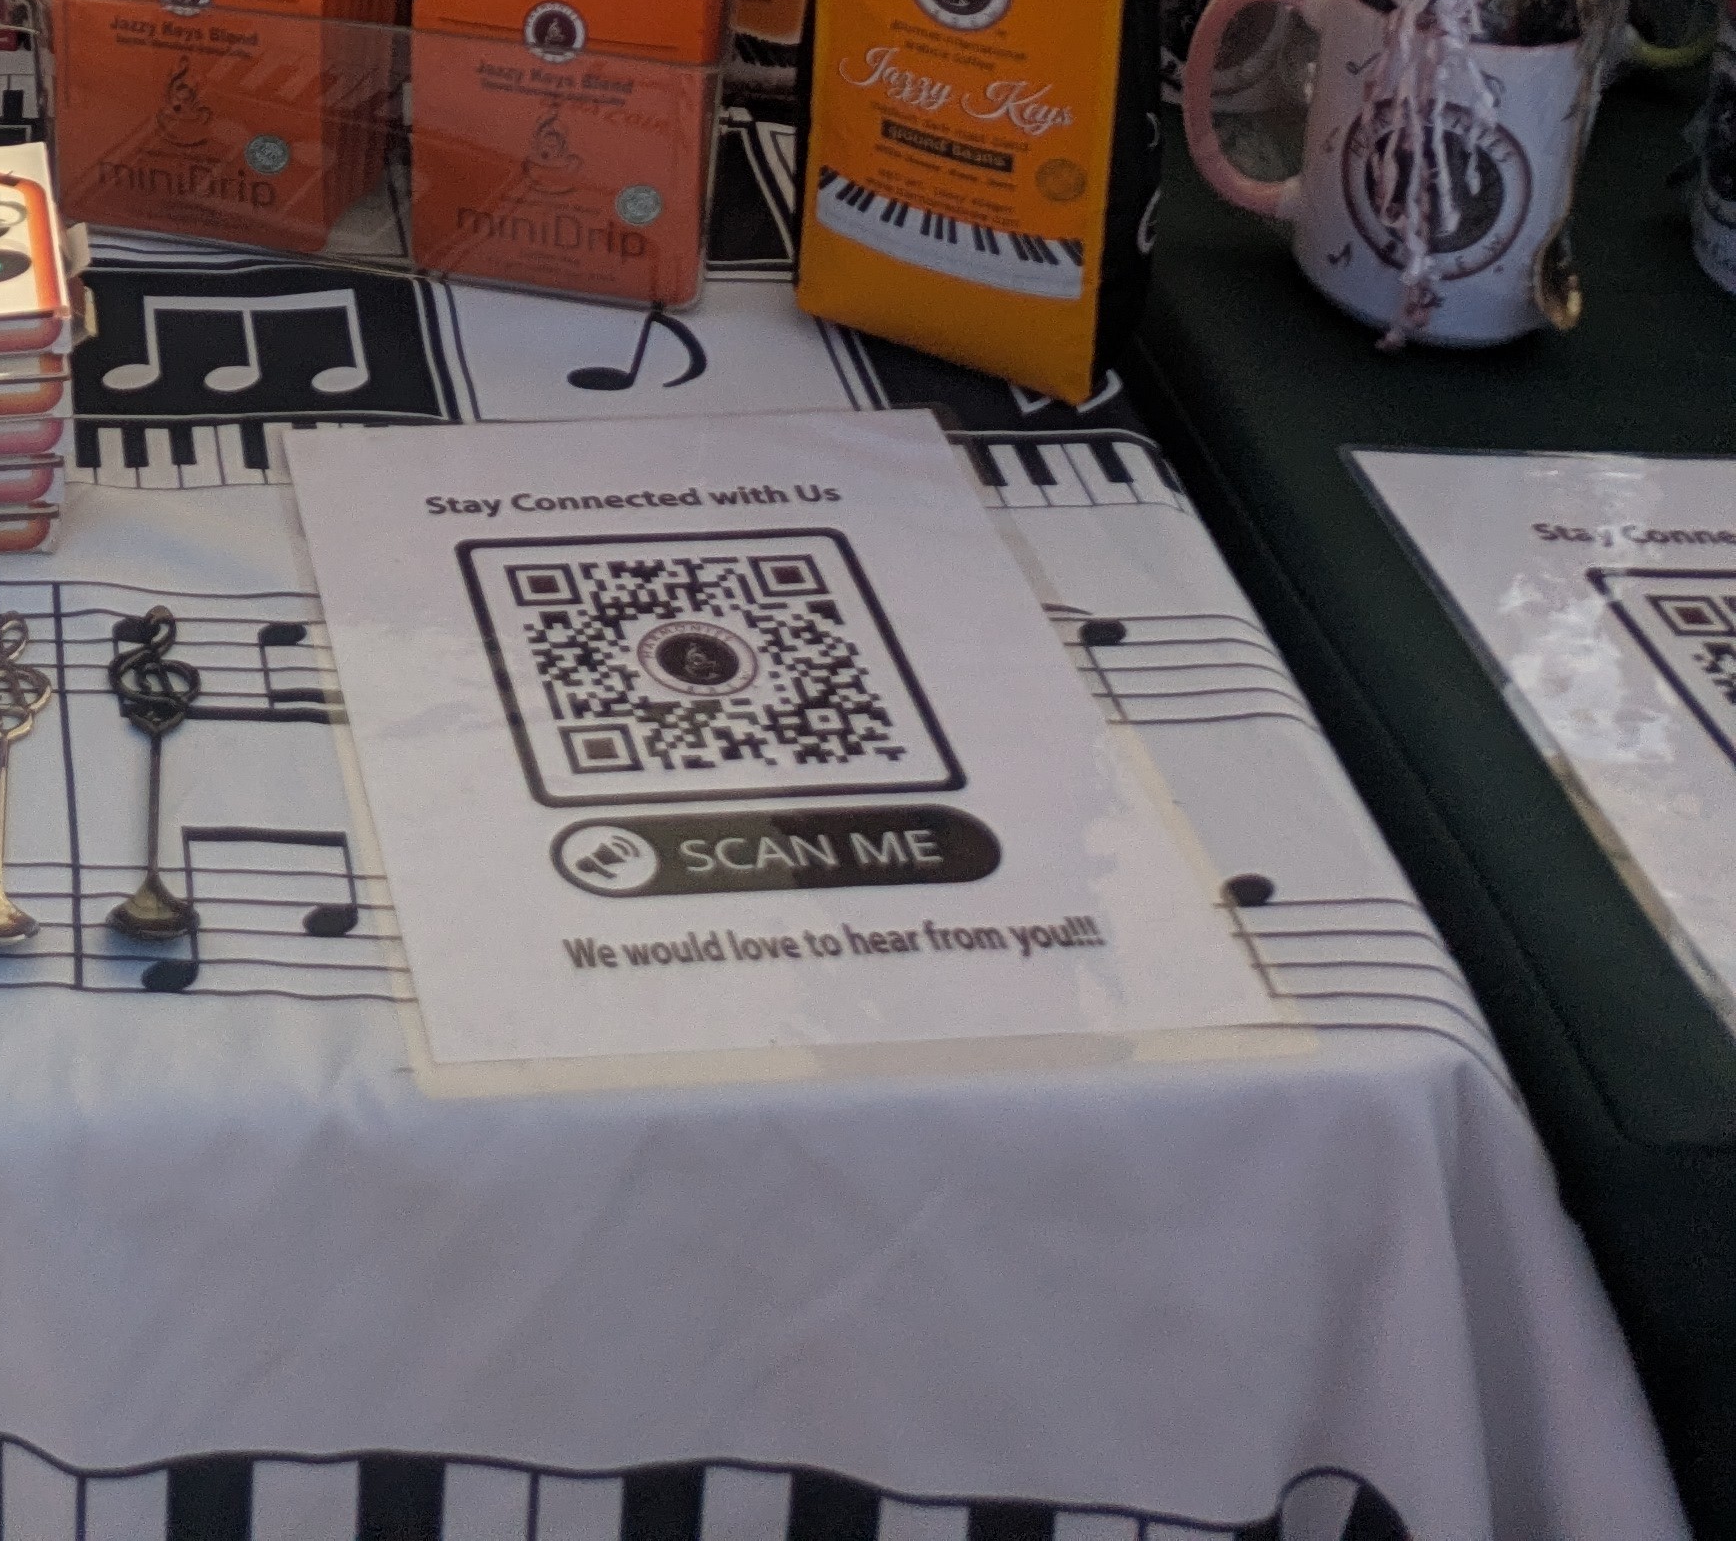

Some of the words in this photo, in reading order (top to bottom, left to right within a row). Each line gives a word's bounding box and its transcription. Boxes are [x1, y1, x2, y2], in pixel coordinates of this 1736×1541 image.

[110, 17, 156, 36] Jazzy
[209, 27, 259, 45] Blend
[838, 47, 952, 111] Jazzy
[961, 81, 1074, 136] Keys
[98, 161, 276, 208] miniDrip
[457, 207, 647, 265] miniDrip
[424, 493, 501, 518] Stay
[511, 487, 702, 514] Connected
[709, 484, 787, 509] with
[795, 483, 841, 503] Us
[640, 620, 735, 660] HARMONIES
[681, 835, 840, 873] SCAN
[850, 830, 943, 867] ME
[564, 938, 618, 970] We
[622, 931, 724, 968] would
[728, 929, 800, 963] love
[807, 931, 841, 956] to
[849, 924, 921, 955] hear
[923, 920, 1008, 954] from
[1015, 917, 1106, 959] you!!!
